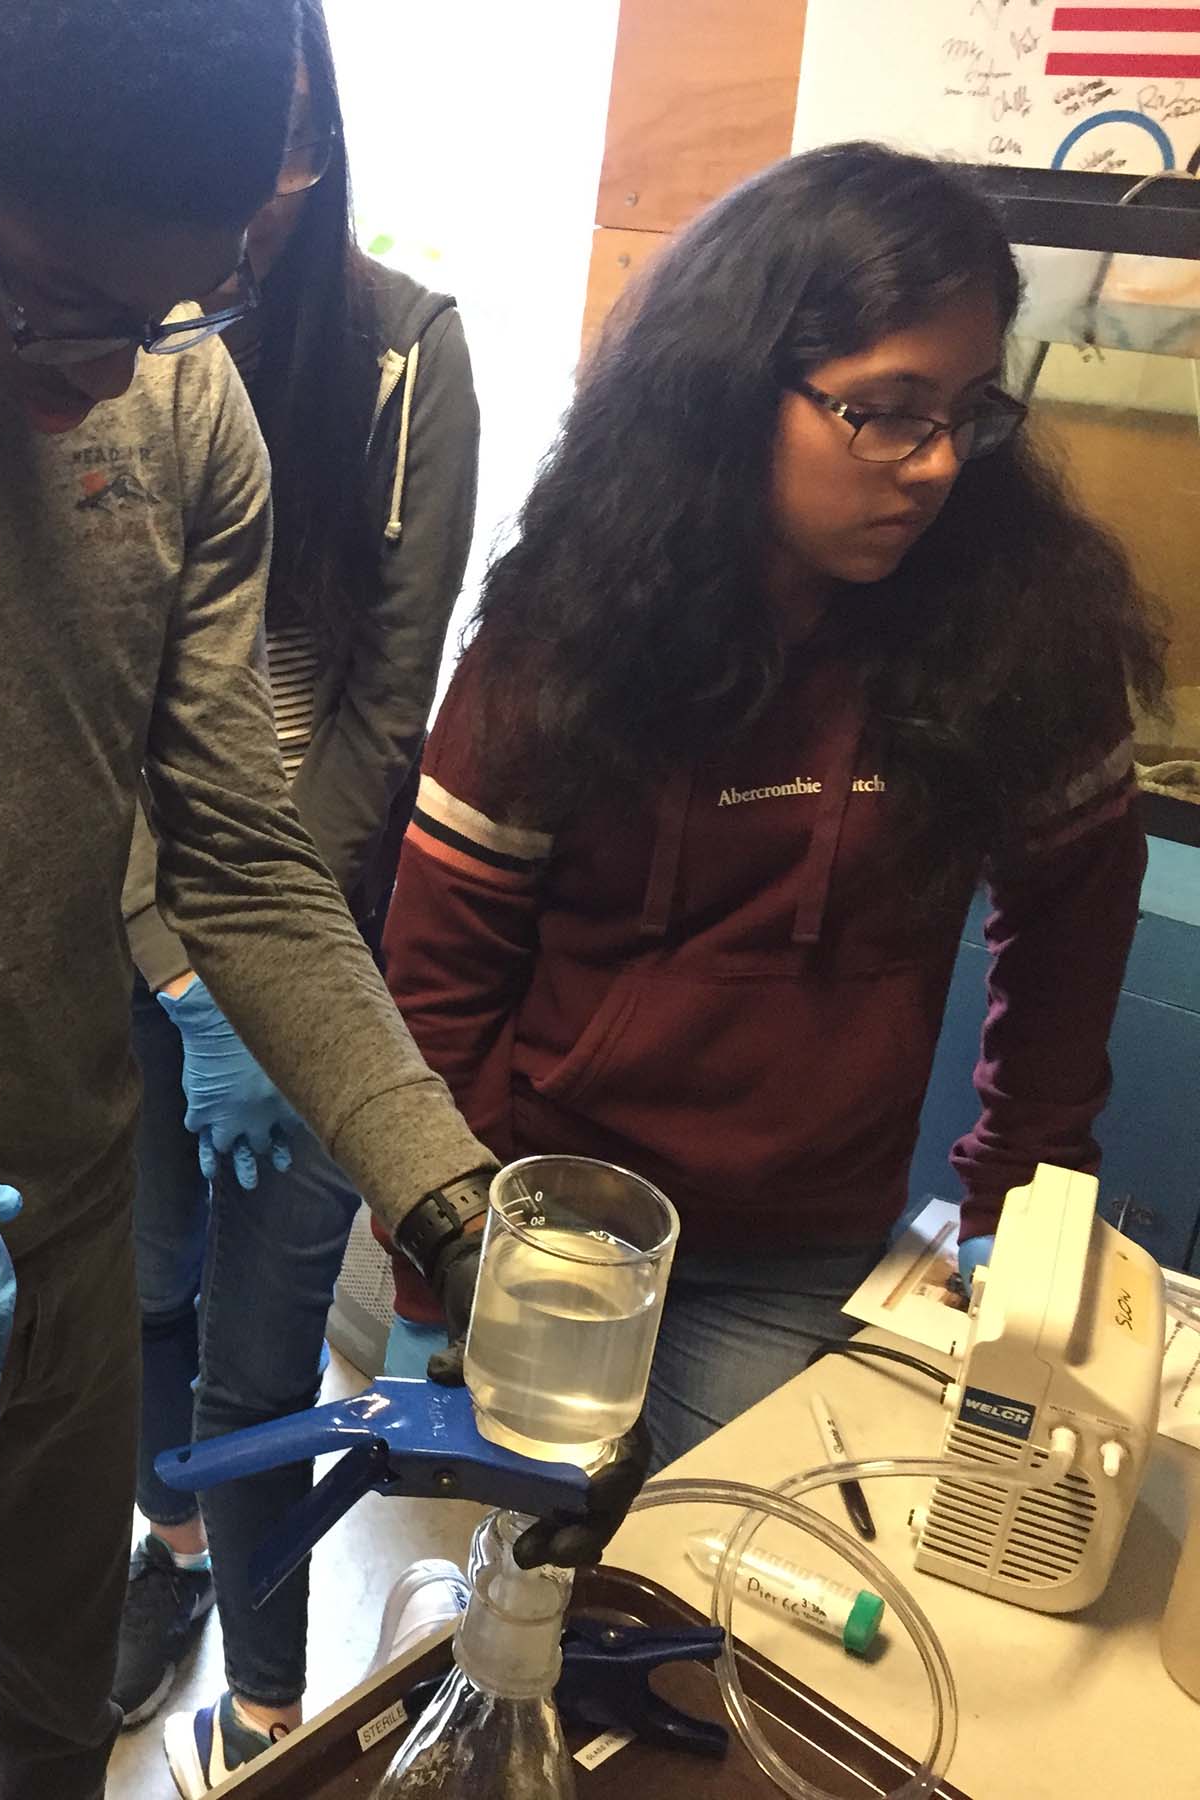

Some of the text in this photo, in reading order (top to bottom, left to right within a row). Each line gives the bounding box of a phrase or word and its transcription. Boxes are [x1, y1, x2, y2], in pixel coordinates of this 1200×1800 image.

[717, 774, 887, 807] Abercrombie itch
[965, 1398, 1030, 1425] WELCH
[747, 1576, 778, 1604] Pier
[362, 1706, 406, 1743] STERILE
